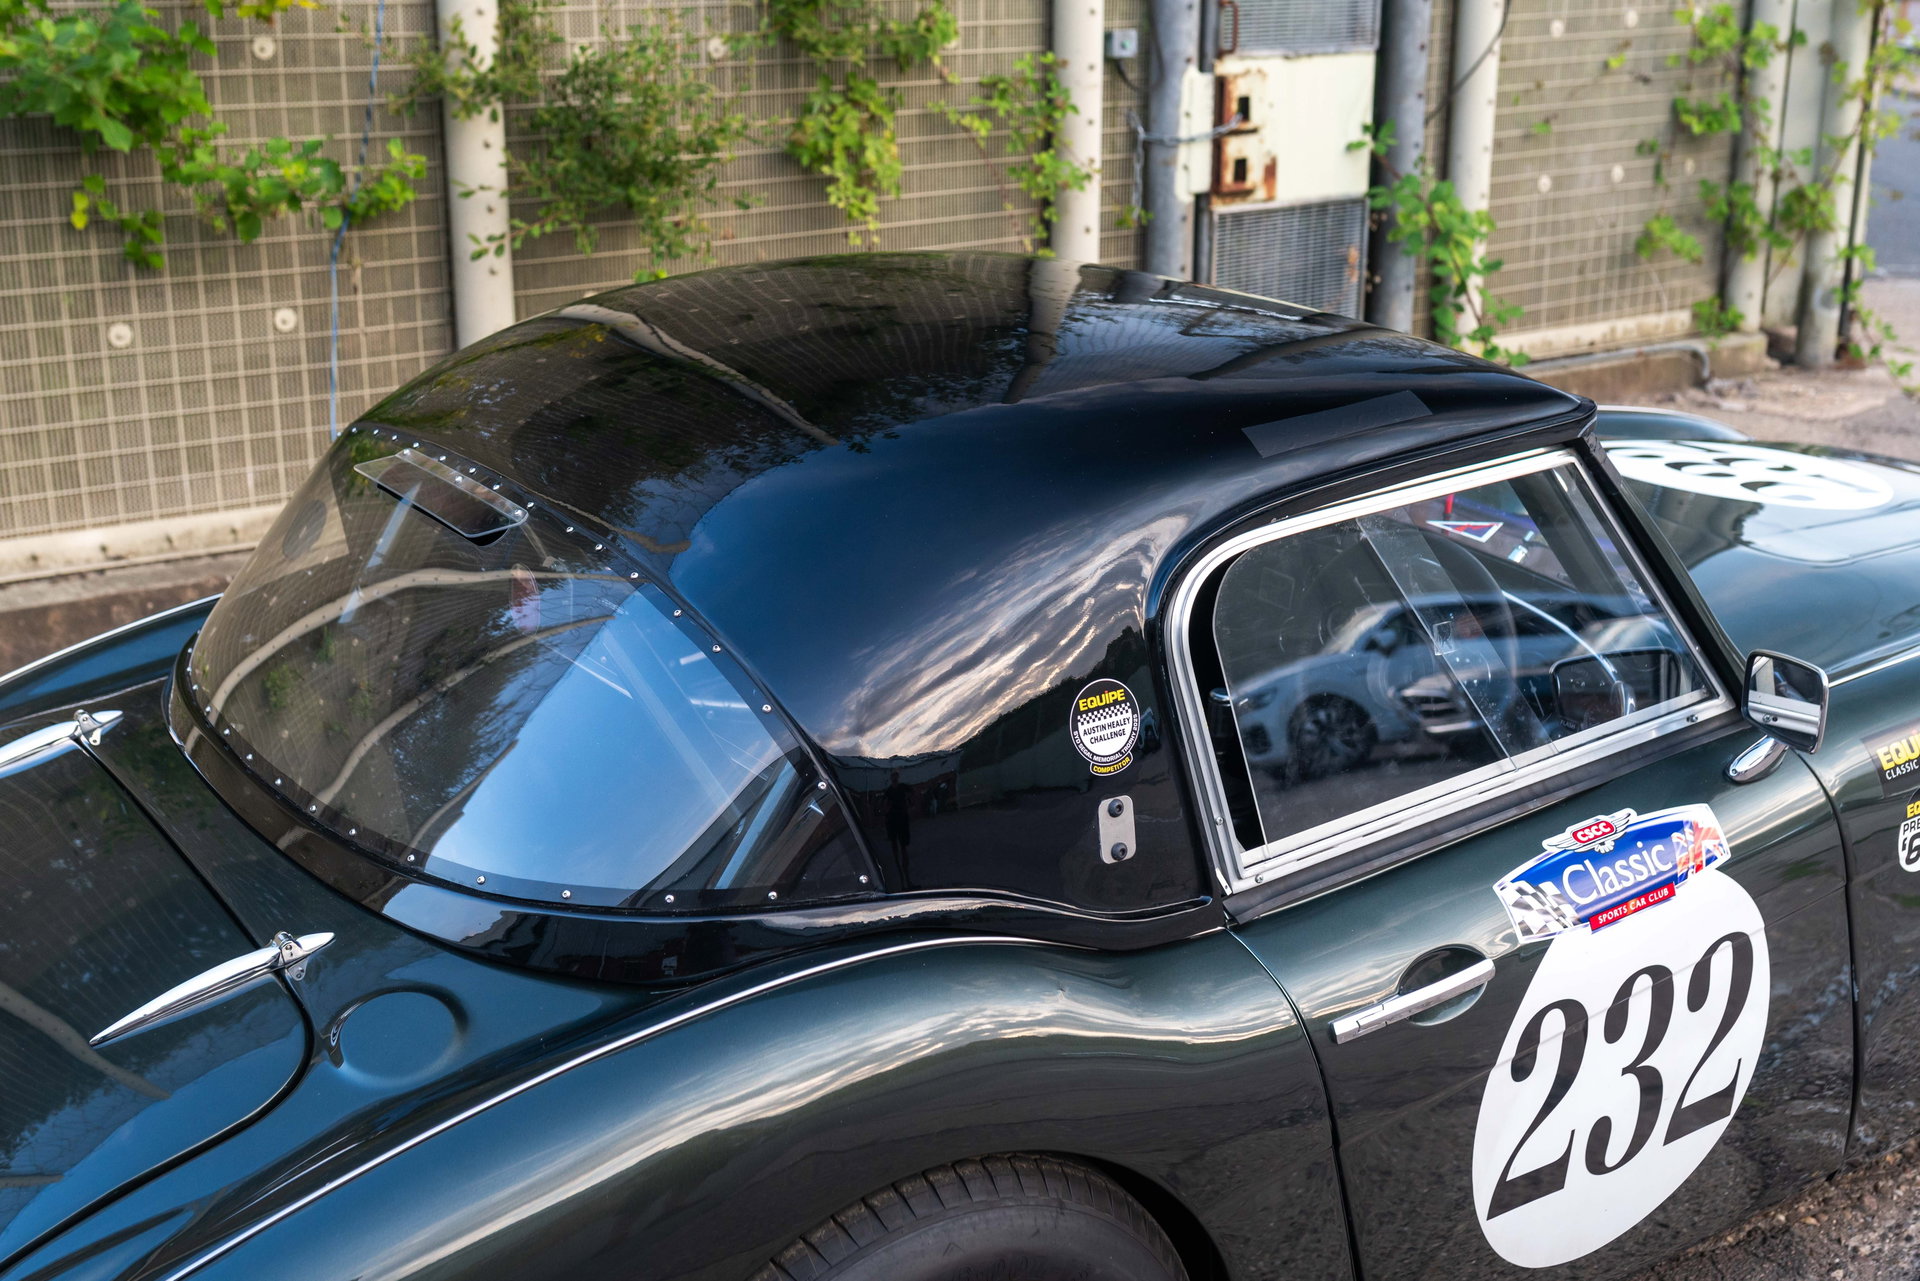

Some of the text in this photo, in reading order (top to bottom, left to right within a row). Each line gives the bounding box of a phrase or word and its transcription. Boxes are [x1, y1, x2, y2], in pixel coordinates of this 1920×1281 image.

[1083, 717, 1131, 737] AUSTIN HEALEY
[1089, 728, 1127, 745] CHALLENGE
[1073, 730, 1081, 745] SYD
[1078, 744, 1093, 759] SEGAL
[1093, 752, 1122, 763] MEMORIAL
[1121, 731, 1136, 754] TROPHY
[1093, 756, 1131, 773] COMPETITOR
[1885, 759, 1919, 780] CLASSIC
[1576, 822, 1611, 842] CSCC
[1562, 841, 1673, 905] Classic
[1597, 887, 1669, 924] SPORTS CAR CLUB
[1487, 931, 1754, 1221] 232
